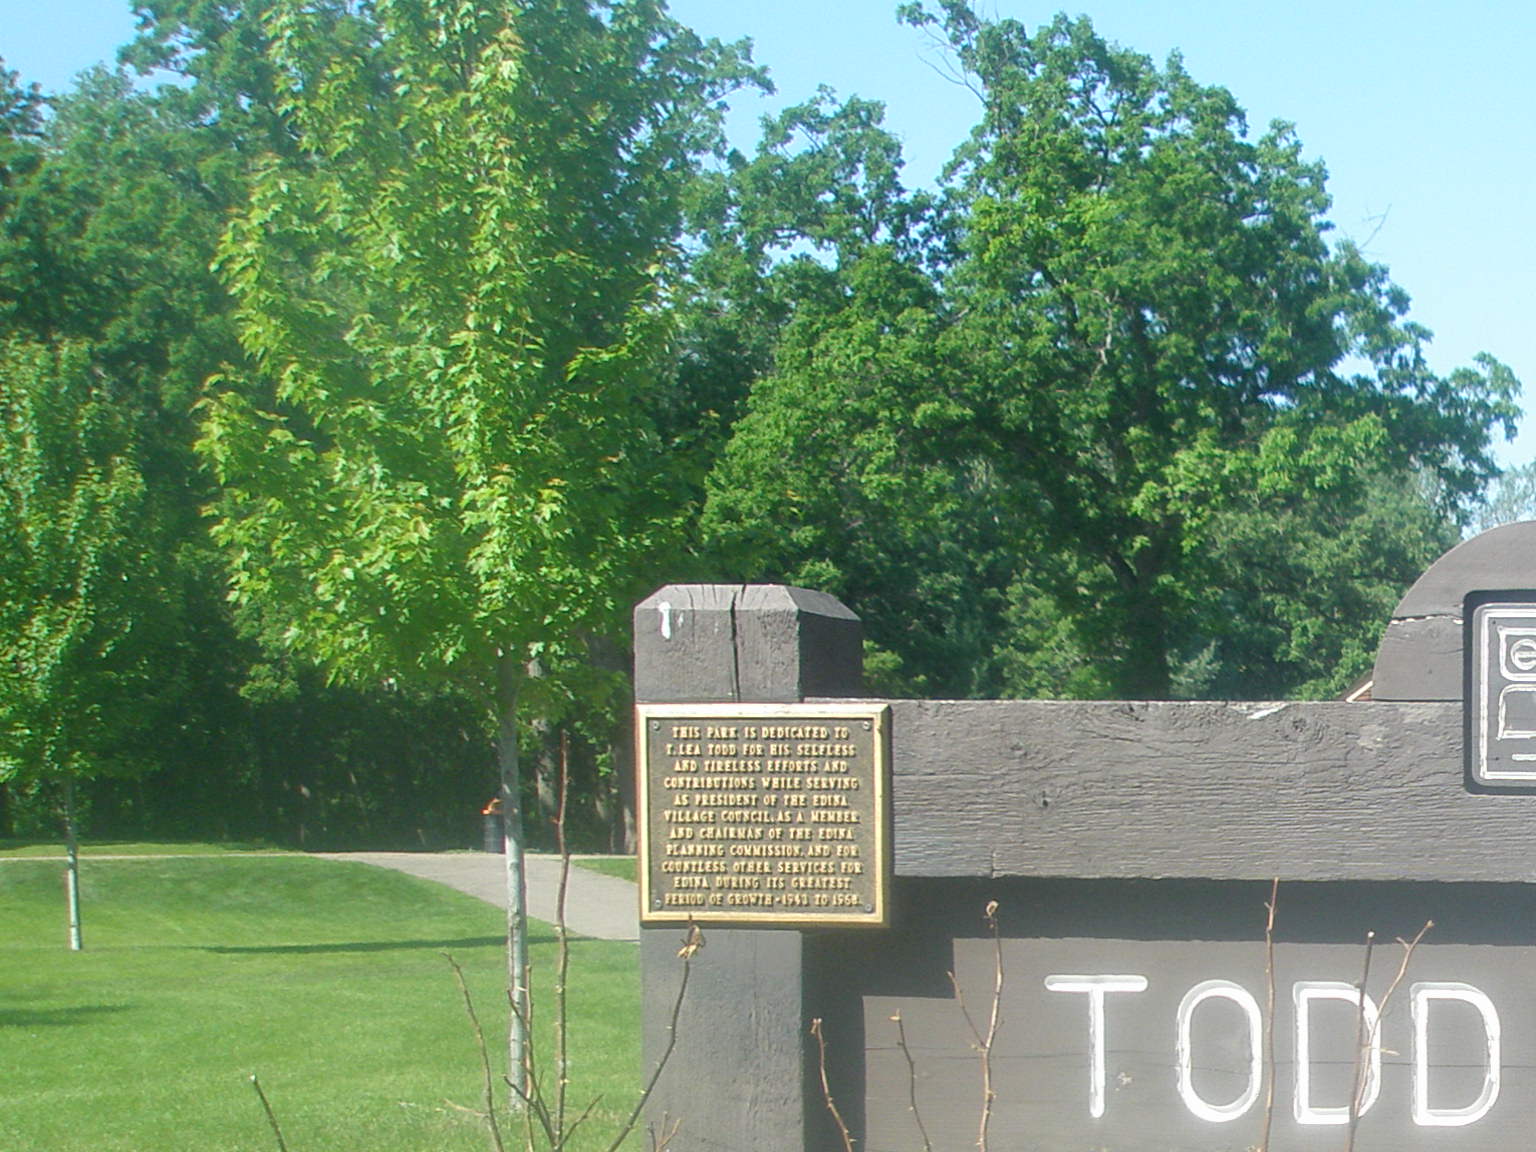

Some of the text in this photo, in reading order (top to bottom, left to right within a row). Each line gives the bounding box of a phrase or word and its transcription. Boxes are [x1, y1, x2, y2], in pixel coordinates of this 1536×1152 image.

[672, 727, 848, 738] THIS PARK IS DEDICATED TO
[680, 744, 700, 755] LEA
[708, 744, 736, 755] TODD
[743, 744, 763, 755] FOR
[771, 744, 789, 755] HIS
[797, 744, 855, 755] SELFLESS
[674, 760, 847, 772] AND TIRELESS EFFORTS AND
[664, 777, 858, 788] CONTRIBUTIONS WHILE SERVING
[674, 795, 847, 806] AS PRESIDENT OF THE EDINA
[664, 811, 714, 822] VILLAGE
[778, 811, 791, 822] AS
[797, 811, 802, 822] A
[811, 811, 859, 822] MEMBER
[670, 828, 852, 839] AND CHAIRMAN OF THE EDINA
[666, 845, 725, 856] PLANNING
[808, 845, 830, 856] AND
[837, 845, 859, 856] FOR
[662, 862, 862, 873] COUNTLESS OTHER SERVICES FOR
[674, 877, 851, 888] EDINA DURING ITS GREATEST
[665, 894, 704, 905] PERIOD
[709, 894, 723, 905] OF
[815, 894, 827, 905] TO
[1044, 972, 1504, 1130] TODD
